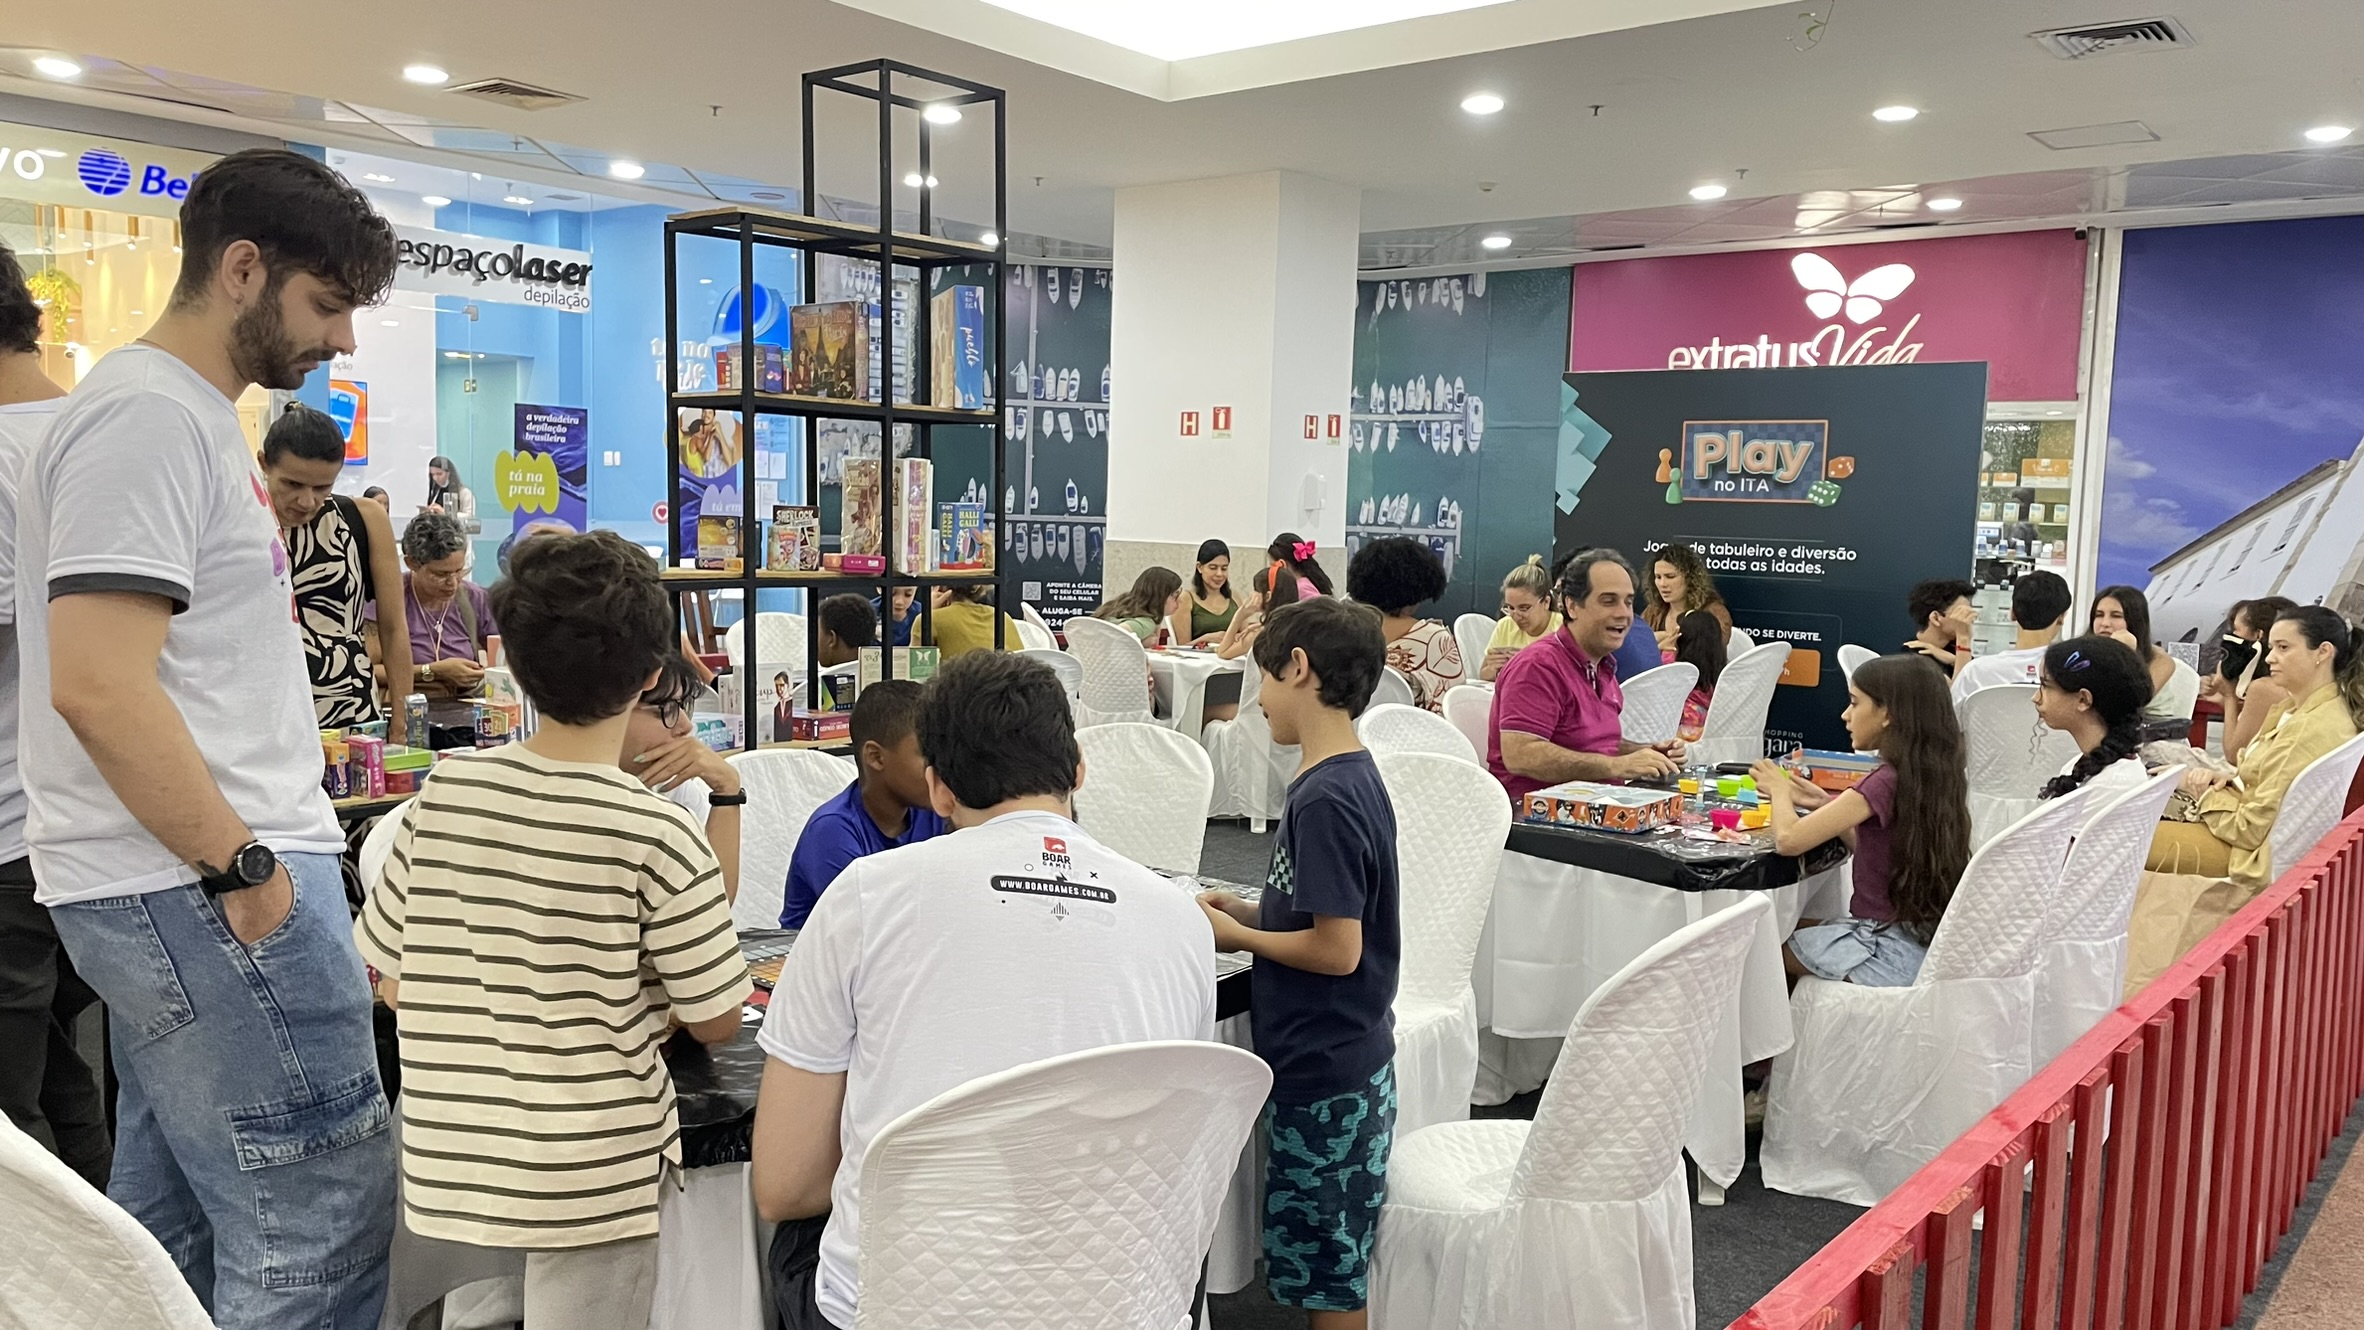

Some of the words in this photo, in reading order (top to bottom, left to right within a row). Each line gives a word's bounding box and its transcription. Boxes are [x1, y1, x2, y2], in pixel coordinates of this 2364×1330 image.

[524, 285, 590, 309] depilação
[525, 413, 533, 422] a
[534, 414, 580, 425] verdadeira
[525, 422, 568, 435] depilação
[525, 432, 566, 443] brasileira
[1693, 430, 1815, 484] Play
[508, 469, 523, 482] tá
[526, 472, 543, 482] na
[508, 484, 546, 498] praia
[1714, 480, 1735, 492] no
[1740, 479, 1769, 492] ITA
[1710, 543, 1775, 558] tabuleiro
[1778, 549, 1788, 558] e
[1791, 546, 1857, 561] diversão
[1706, 557, 1746, 571] todas
[1750, 561, 1768, 571] as
[1771, 560, 1825, 575] idades.
[1042, 607, 1083, 615] ALUGA-SE
[1762, 629, 1775, 639] SE
[1776, 631, 1822, 642] DIVERTE.
[1764, 729, 1804, 739] HOPPING
[1042, 852, 1071, 864] BOAR
[1042, 861, 1072, 870] GAMES
[999, 879, 1109, 900] WWW.BOARGAMES.COM.BR
